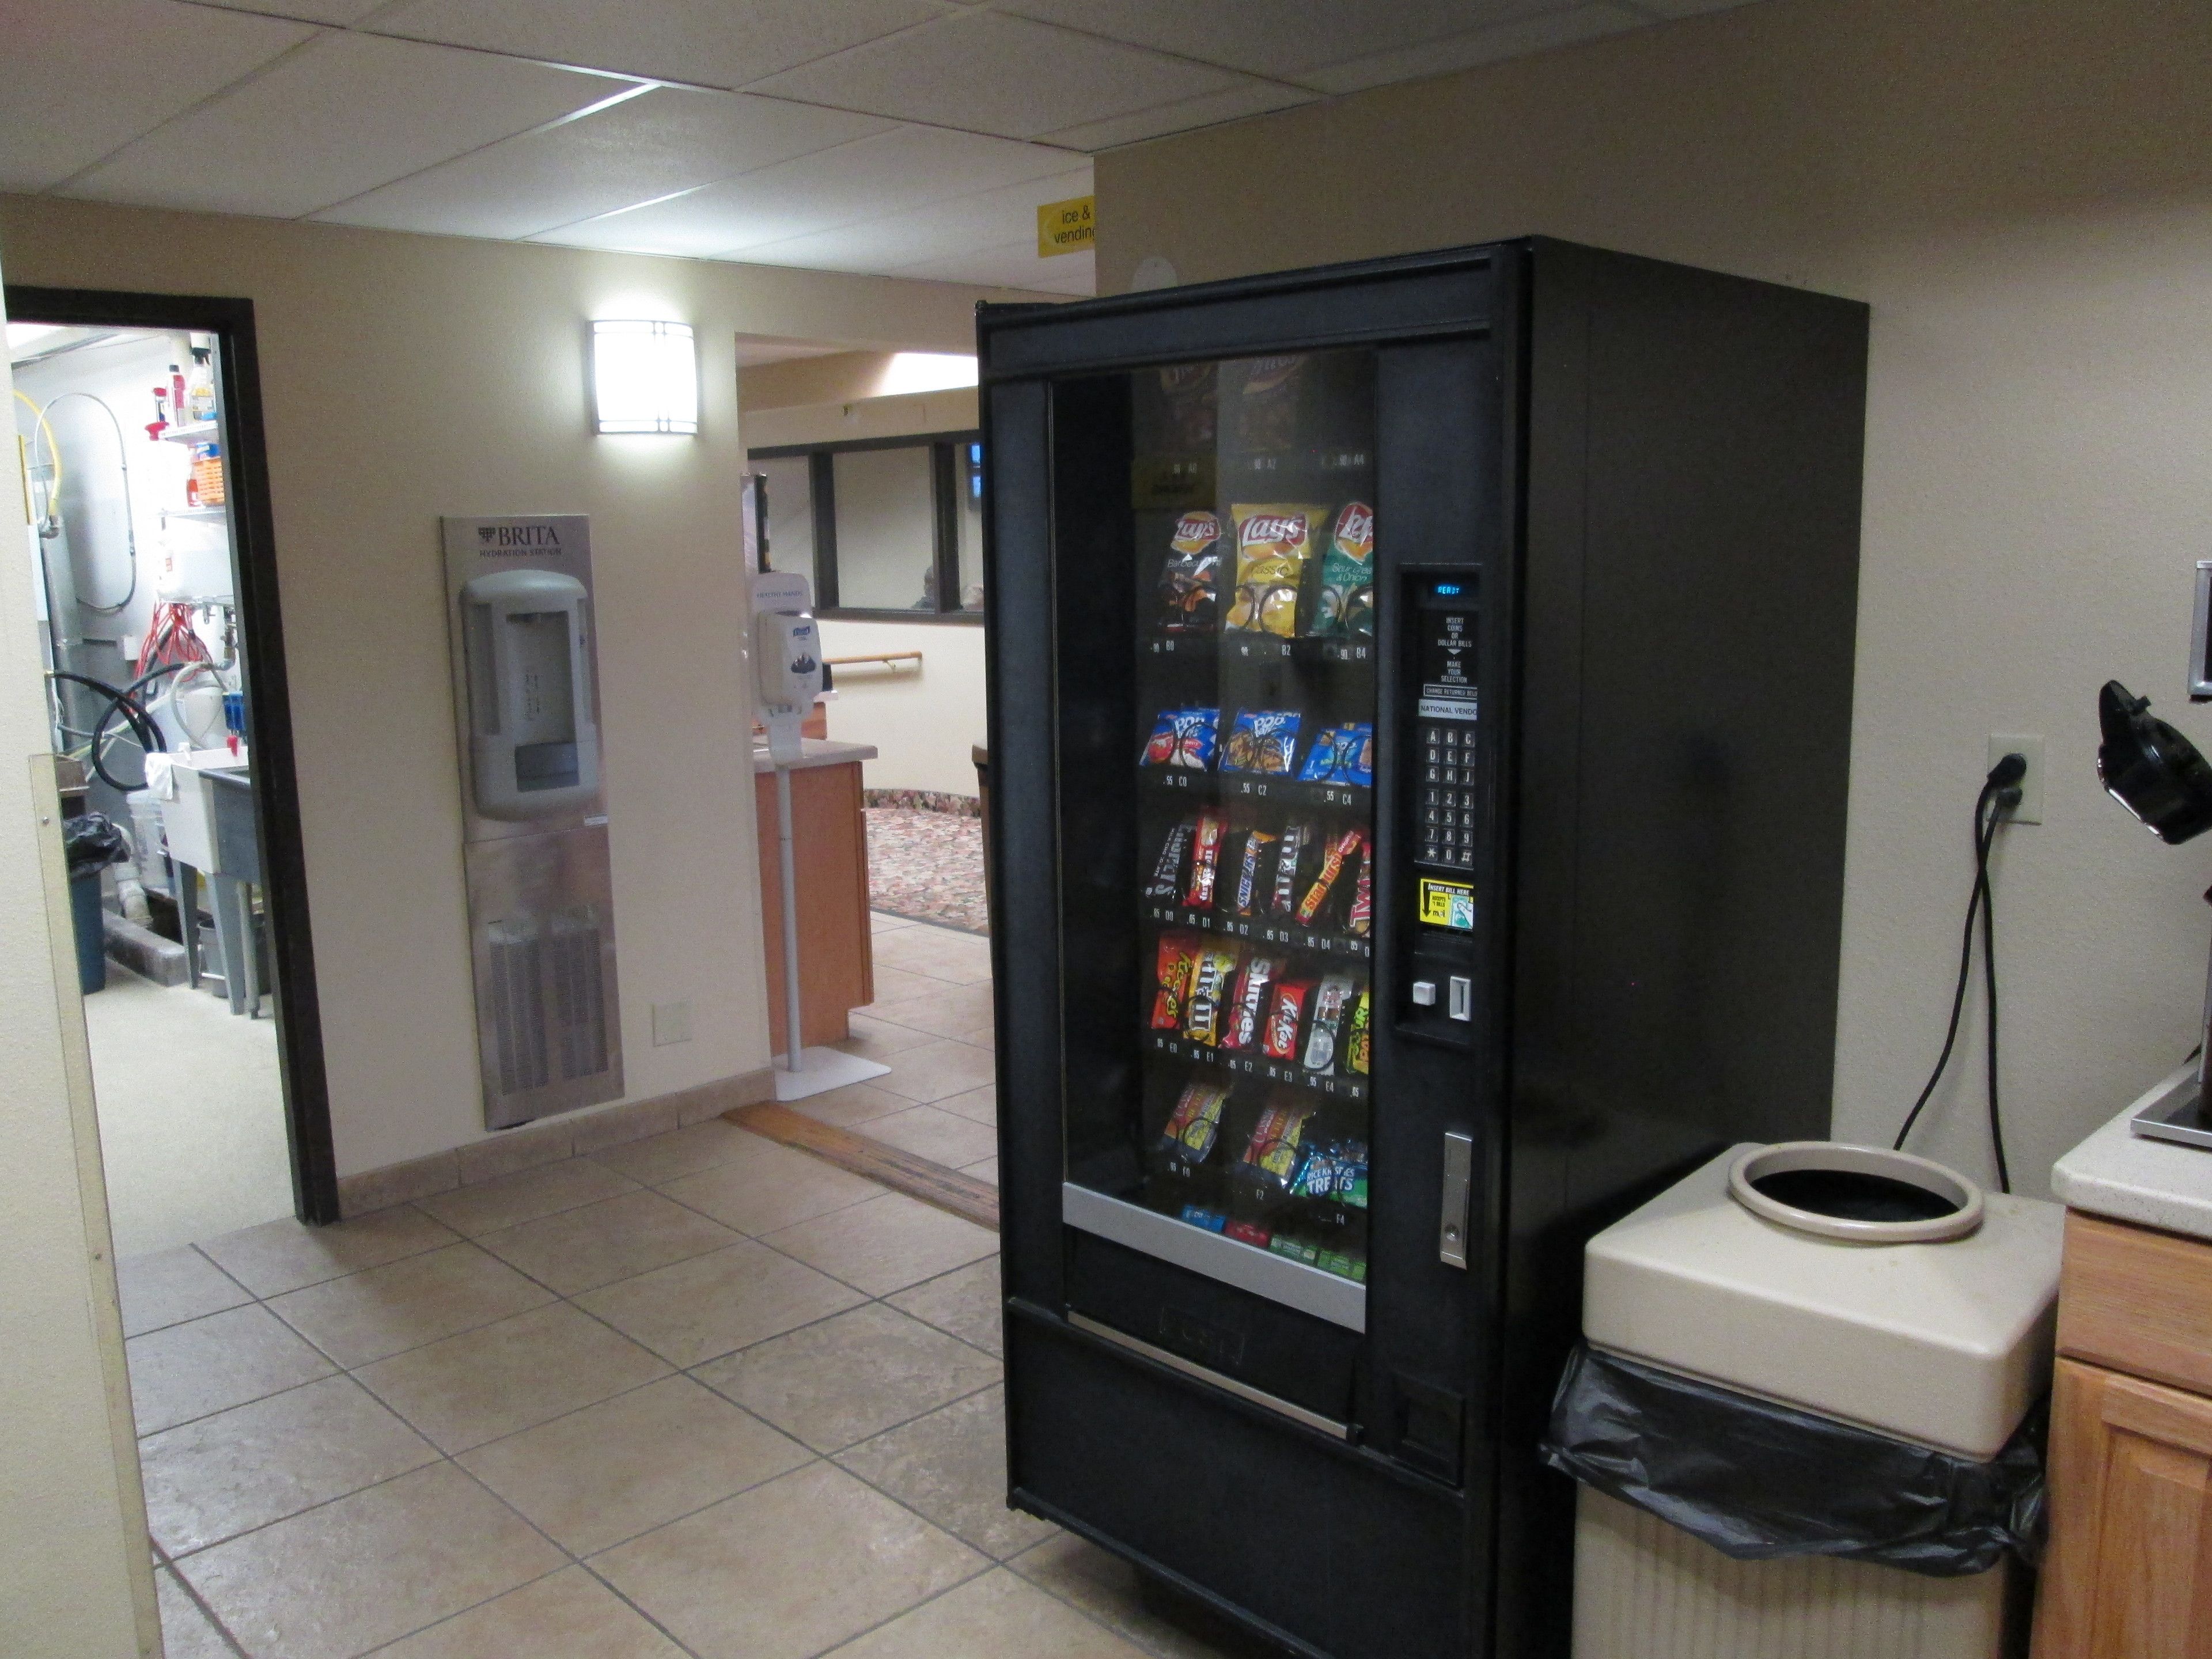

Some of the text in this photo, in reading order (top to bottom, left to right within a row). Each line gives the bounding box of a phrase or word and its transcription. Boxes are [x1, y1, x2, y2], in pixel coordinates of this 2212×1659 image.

[1062, 204, 1090, 224] ice &
[498, 526, 560, 546] BRITA
[1437, 585, 1460, 594] READY
[1441, 675, 1468, 683] SELECTION
[1421, 704, 1452, 714] NATIONAL
[1430, 730, 1471, 744] A B C
[1430, 749, 1470, 763] D E F
[1430, 768, 1469, 782] G H J
[1258, 784, 1267, 796] C2
[1342, 794, 1352, 805] C4
[1430, 791, 1469, 806] 1 2 3
[1429, 810, 1469, 825] 4 5 6
[1429, 828, 1469, 843] 7 8 9
[1446, 849, 1452, 860] 0
[1427, 883, 1445, 892] INSERT
[1277, 1018, 1294, 1049] Kat
